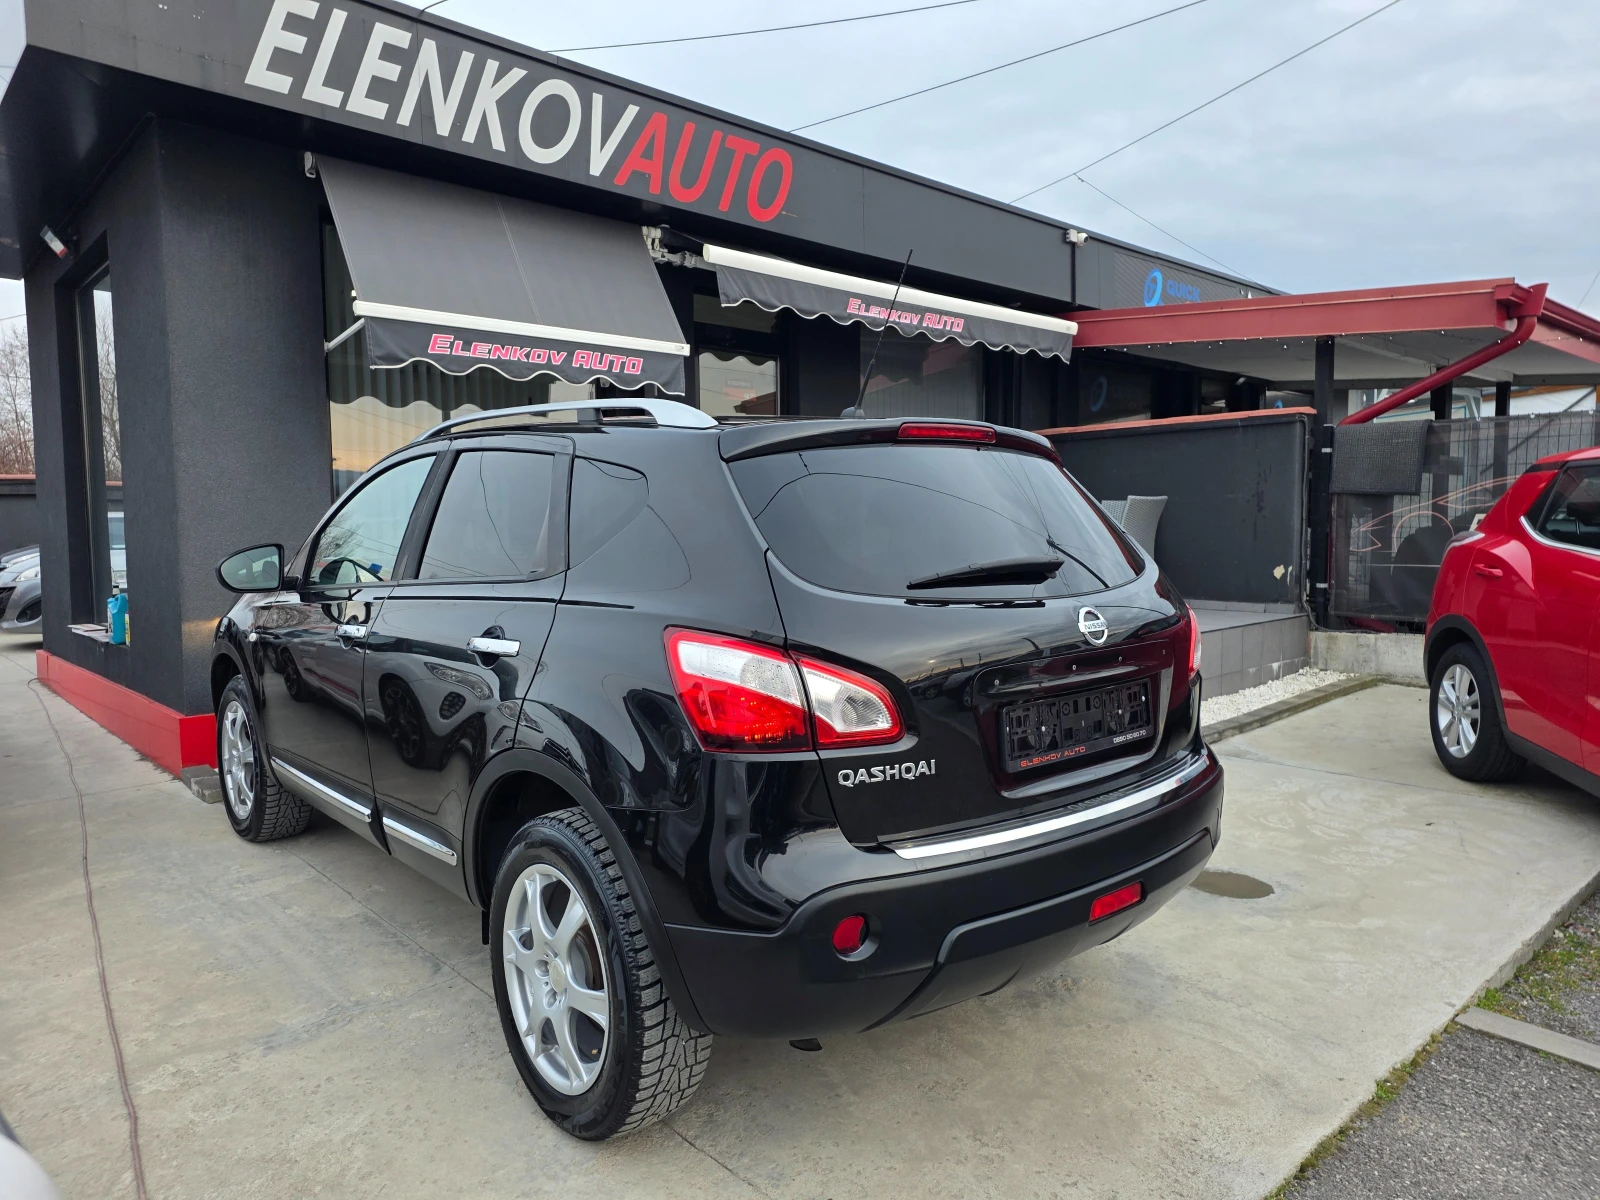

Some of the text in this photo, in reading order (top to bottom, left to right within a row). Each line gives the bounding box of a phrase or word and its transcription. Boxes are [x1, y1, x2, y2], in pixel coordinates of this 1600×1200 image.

[613, 111, 794, 223] AUTO
[923, 312, 964, 332] AUTO
[428, 333, 643, 375] ELENKOV AUTO
[1064, 746, 1086, 756] AUTO
[838, 760, 936, 787] QASHQAI
